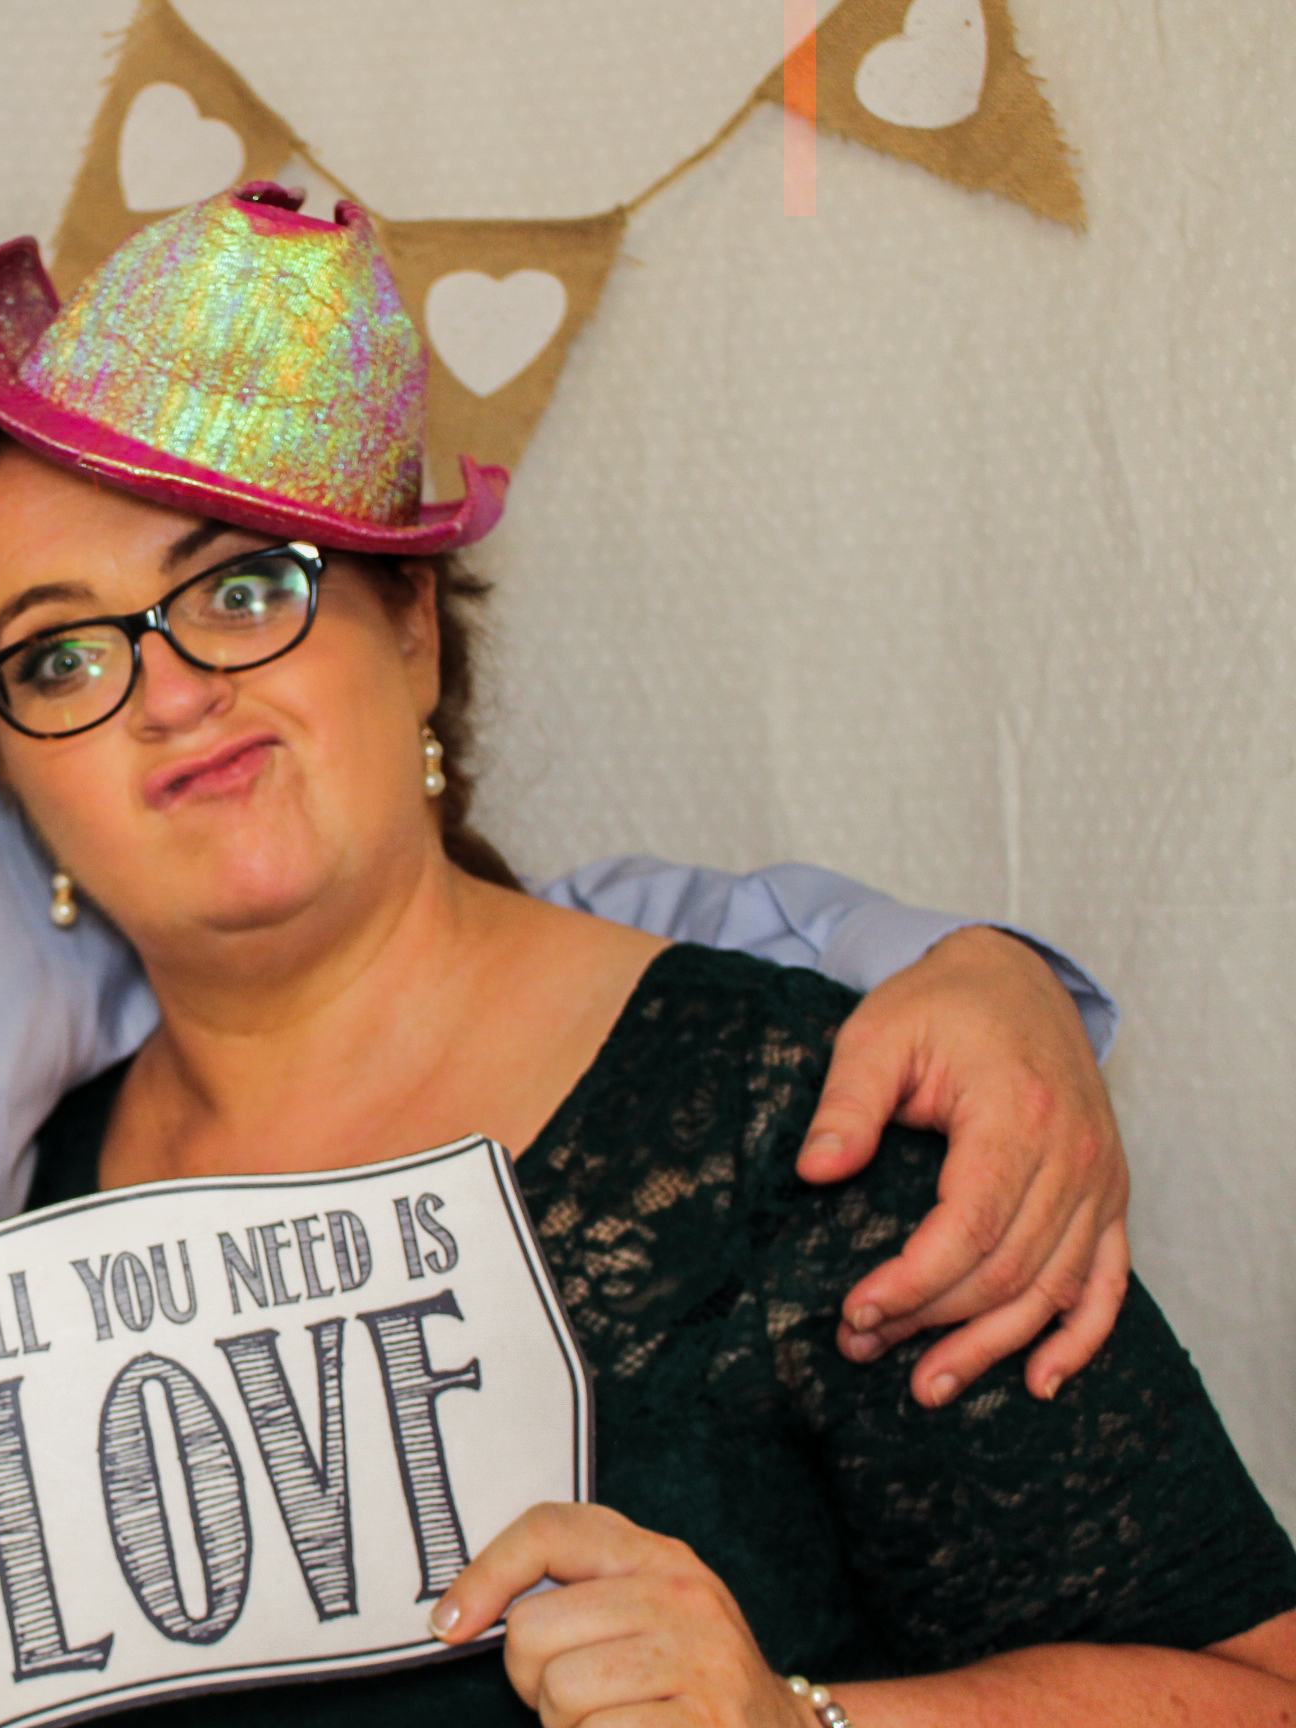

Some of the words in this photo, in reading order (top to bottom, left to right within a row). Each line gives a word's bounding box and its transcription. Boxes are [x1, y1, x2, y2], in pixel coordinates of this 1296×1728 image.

[70, 1238, 198, 1342] YOU
[217, 1208, 373, 1314] NEED
[393, 1191, 460, 1280] IS
